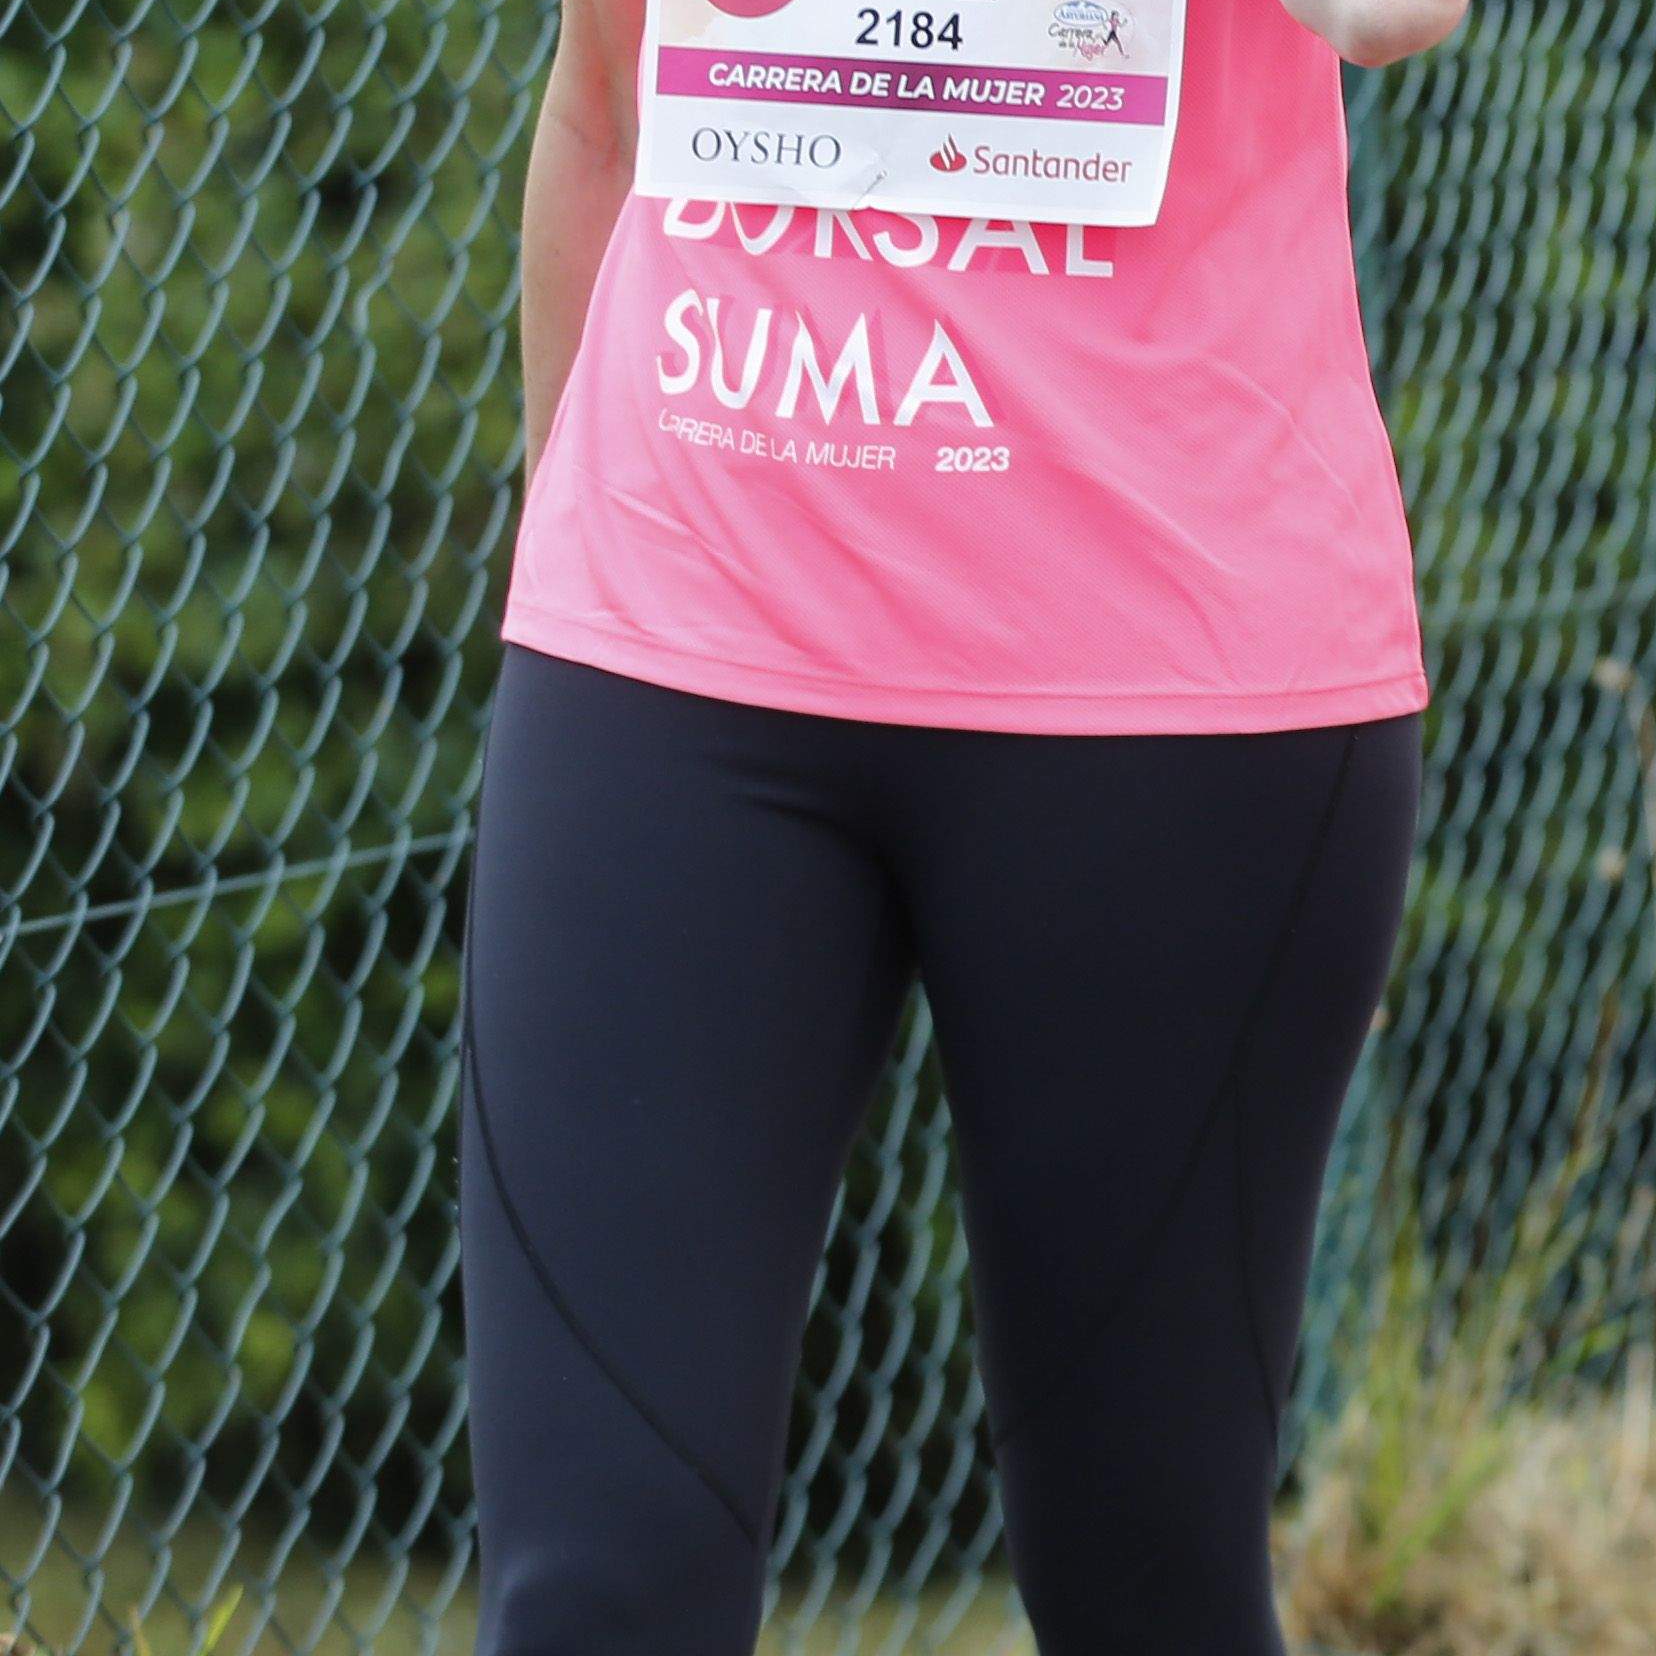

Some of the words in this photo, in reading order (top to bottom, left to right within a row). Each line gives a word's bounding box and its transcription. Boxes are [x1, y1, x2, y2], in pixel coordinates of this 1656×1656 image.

[856, 7, 963, 51] 2184
[708, 62, 842, 95] CARRERA
[850, 71, 890, 97] DE
[896, 75, 935, 101] LA
[942, 77, 1045, 107] MUJER
[1055, 83, 1124, 111] 2023
[691, 127, 842, 169] OYSHO
[972, 144, 1133, 183] Santander
[656, 287, 994, 429] SUMA
[740, 429, 766, 457] DE
[772, 439, 798, 464] LA
[804, 441, 896, 471] MUJER
[935, 446, 1010, 472] 2023
